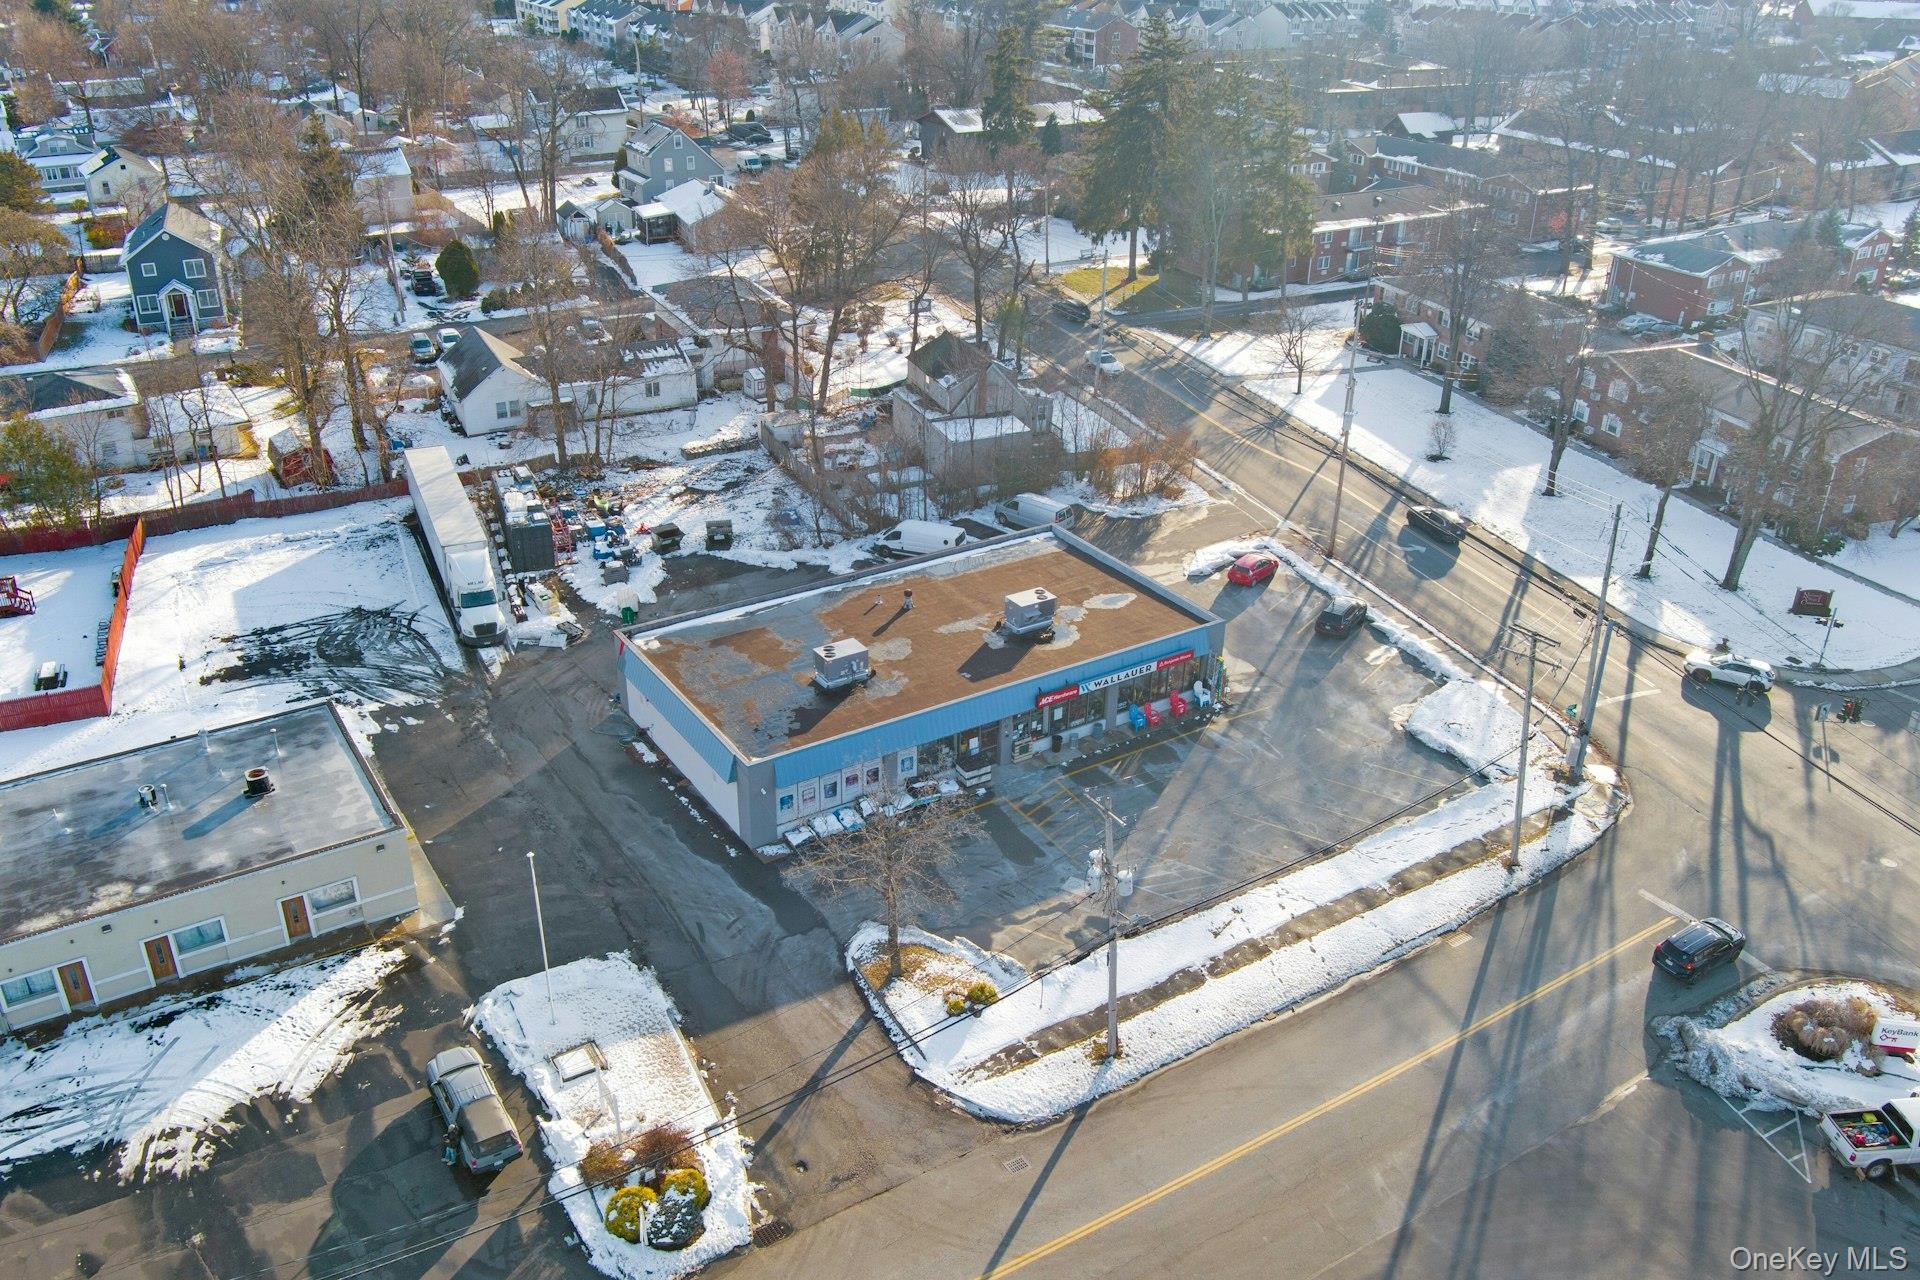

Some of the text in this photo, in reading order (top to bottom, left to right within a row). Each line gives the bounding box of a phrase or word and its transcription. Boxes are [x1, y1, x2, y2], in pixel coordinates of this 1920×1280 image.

[1093, 664, 1152, 688] WALLAUER
[1039, 696, 1054, 705] ACE
[1881, 1027, 1919, 1037] KeyBank
